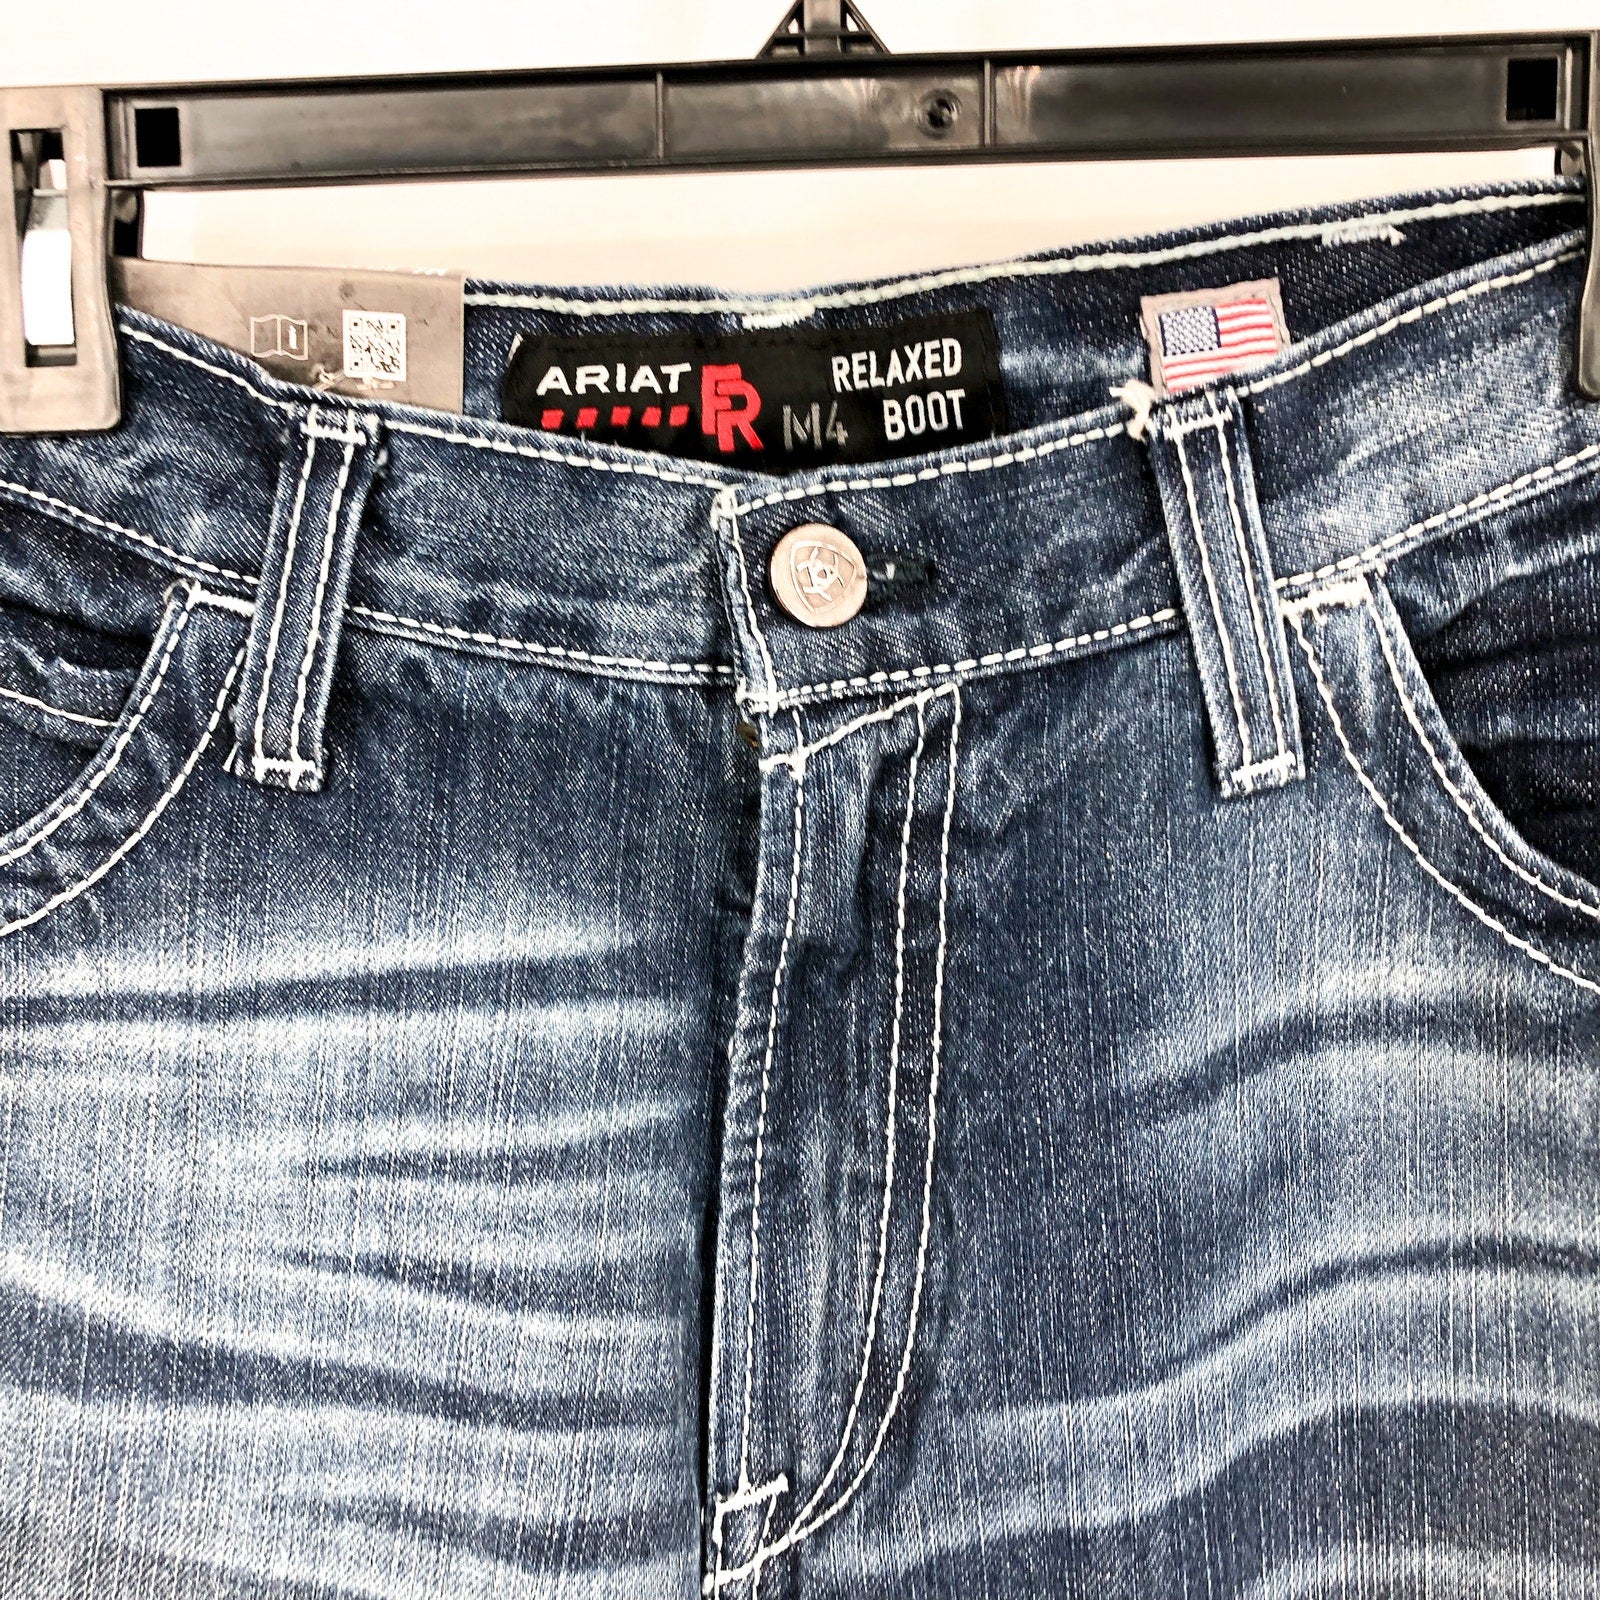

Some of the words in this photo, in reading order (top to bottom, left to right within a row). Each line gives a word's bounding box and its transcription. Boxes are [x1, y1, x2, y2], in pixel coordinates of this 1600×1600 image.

[536, 363, 692, 396] ARIAT
[831, 337, 963, 392] RELAXED
[782, 401, 849, 452] M4
[883, 388, 966, 441] BOOT
